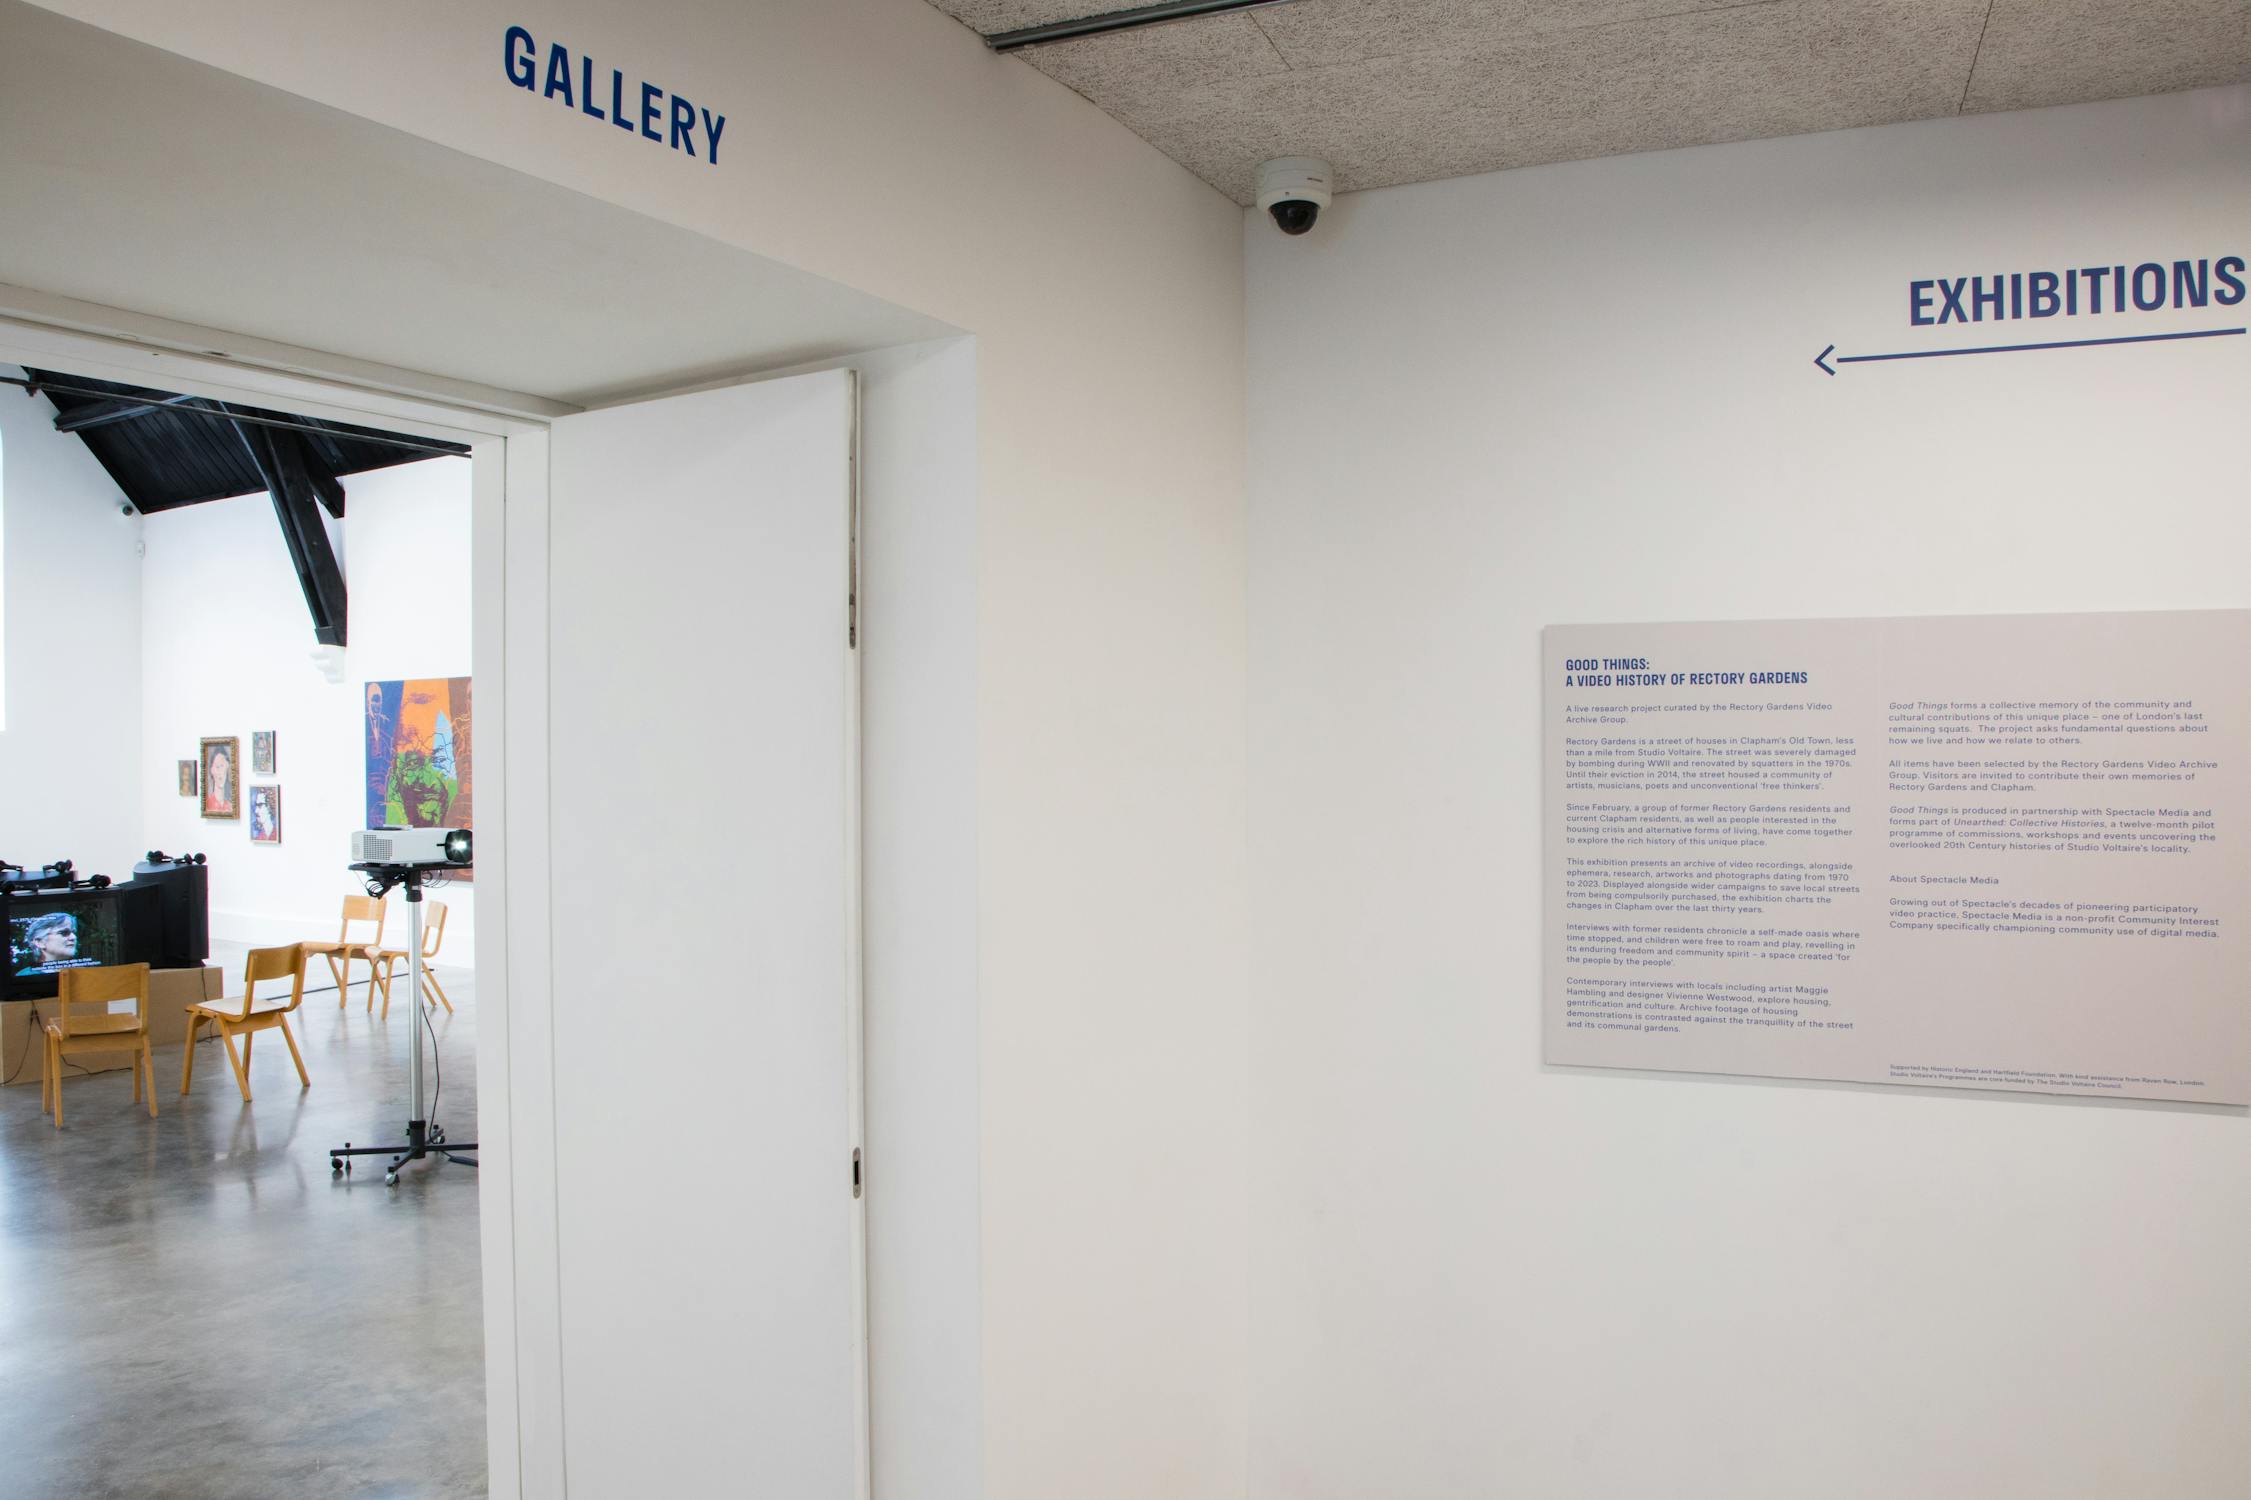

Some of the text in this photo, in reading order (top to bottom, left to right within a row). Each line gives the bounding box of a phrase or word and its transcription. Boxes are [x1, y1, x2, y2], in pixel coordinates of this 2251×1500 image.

[504, 25, 726, 165] GALLERY
[1910, 256, 2247, 326] EXHIBITIONS
[1566, 658, 1650, 671] GOOD THINGS:
[1565, 671, 1808, 687] A VIDEO HISTORY OF RECTORY GARDENS
[1565, 702, 1833, 714] A live research project curated by the Rectory Gardens Video
[1888, 702, 1915, 710] Good
[1917, 701, 1949, 712] Things
[1950, 701, 1978, 710] forms
[1988, 701, 2037, 709] collective
[2038, 702, 2079, 710] memory
[2081, 700, 2092, 709] of
[2094, 701, 2111, 709] the
[2113, 700, 2171, 710] community
[2172, 700, 2193, 708] and
[1888, 726, 1936, 735] remaining
[1978, 724, 1996, 733] The
[1998, 724, 2033, 734] project
[2035, 724, 2059, 733] asks
[2061, 724, 2124, 733] fundamental
[2126, 725, 2176, 734] questions
[2178, 724, 2208, 732] about
[1565, 737, 1599, 747] Rectory
[1600, 737, 1637, 746] Gardens
[1638, 738, 1646, 746] is
[1684, 737, 1694, 745] of
[1696, 737, 1728, 745] houses
[1789, 736, 1805, 745] Old
[1835, 736, 1854, 744] less
[1888, 759, 2218, 770] All items have been selected by the Rectory Gardens Video Archive
[1565, 770, 1586, 778] Until
[1588, 770, 1608, 778] their
[1610, 771, 1645, 779] eviction
[1646, 771, 1655, 779] in
[1727, 771, 1761, 779] housed
[1770, 771, 1821, 780] community
[1822, 771, 1833, 779] of
[1889, 782, 1925, 792] Rectory
[1927, 782, 1968, 791] Gardens
[1970, 783, 1988, 791] and
[1566, 803, 1590, 812] Since
[1641, 805, 1667, 814] group
[1669, 804, 1678, 812] of
[1680, 804, 1710, 812] former
[1712, 803, 1747, 813] Rectory
[1748, 804, 1787, 813] Gardens
[1789, 805, 1832, 813] residents
[1833, 806, 1851, 814] and
[1889, 817, 1917, 826] forms
[1918, 818, 1939, 827] part
[1940, 818, 1951, 826] of
[2008, 818, 2059, 827] Collective
[2191, 821, 2215, 831] pilot
[1566, 857, 1585, 866] This
[1586, 858, 1628, 866] exhibition
[1630, 860, 1668, 868] presents
[1683, 860, 1716, 868] archive
[1717, 860, 1728, 868] of
[1729, 860, 1754, 869] video
[1808, 862, 1854, 872] alongside
[1890, 874, 1999, 885] About Spectacle Media
[1889, 897, 1929, 908] Growing
[1930, 899, 1947, 907] out
[1948, 899, 1960, 907] of
[2018, 901, 2062, 910] decades
[2063, 902, 2074, 910] of
[2076, 903, 2130, 914] pioneering
[2132, 904, 2199, 915] participatory
[1566, 923, 1610, 932] Interviews
[1611, 924, 1631, 932] with
[1632, 925, 1662, 933] former
[1663, 926, 1704, 934] residents
[1706, 926, 1748, 936] chronicle
[1805, 930, 1830, 938] oasis
[1831, 930, 1860, 939] where
[1566, 987, 1606, 998] Hambling
[1608, 989, 1625, 998] and
[1626, 990, 1664, 1001] designer
[1666, 992, 1704, 1001] Vivienne
[1757, 995, 1791, 1005] explore
